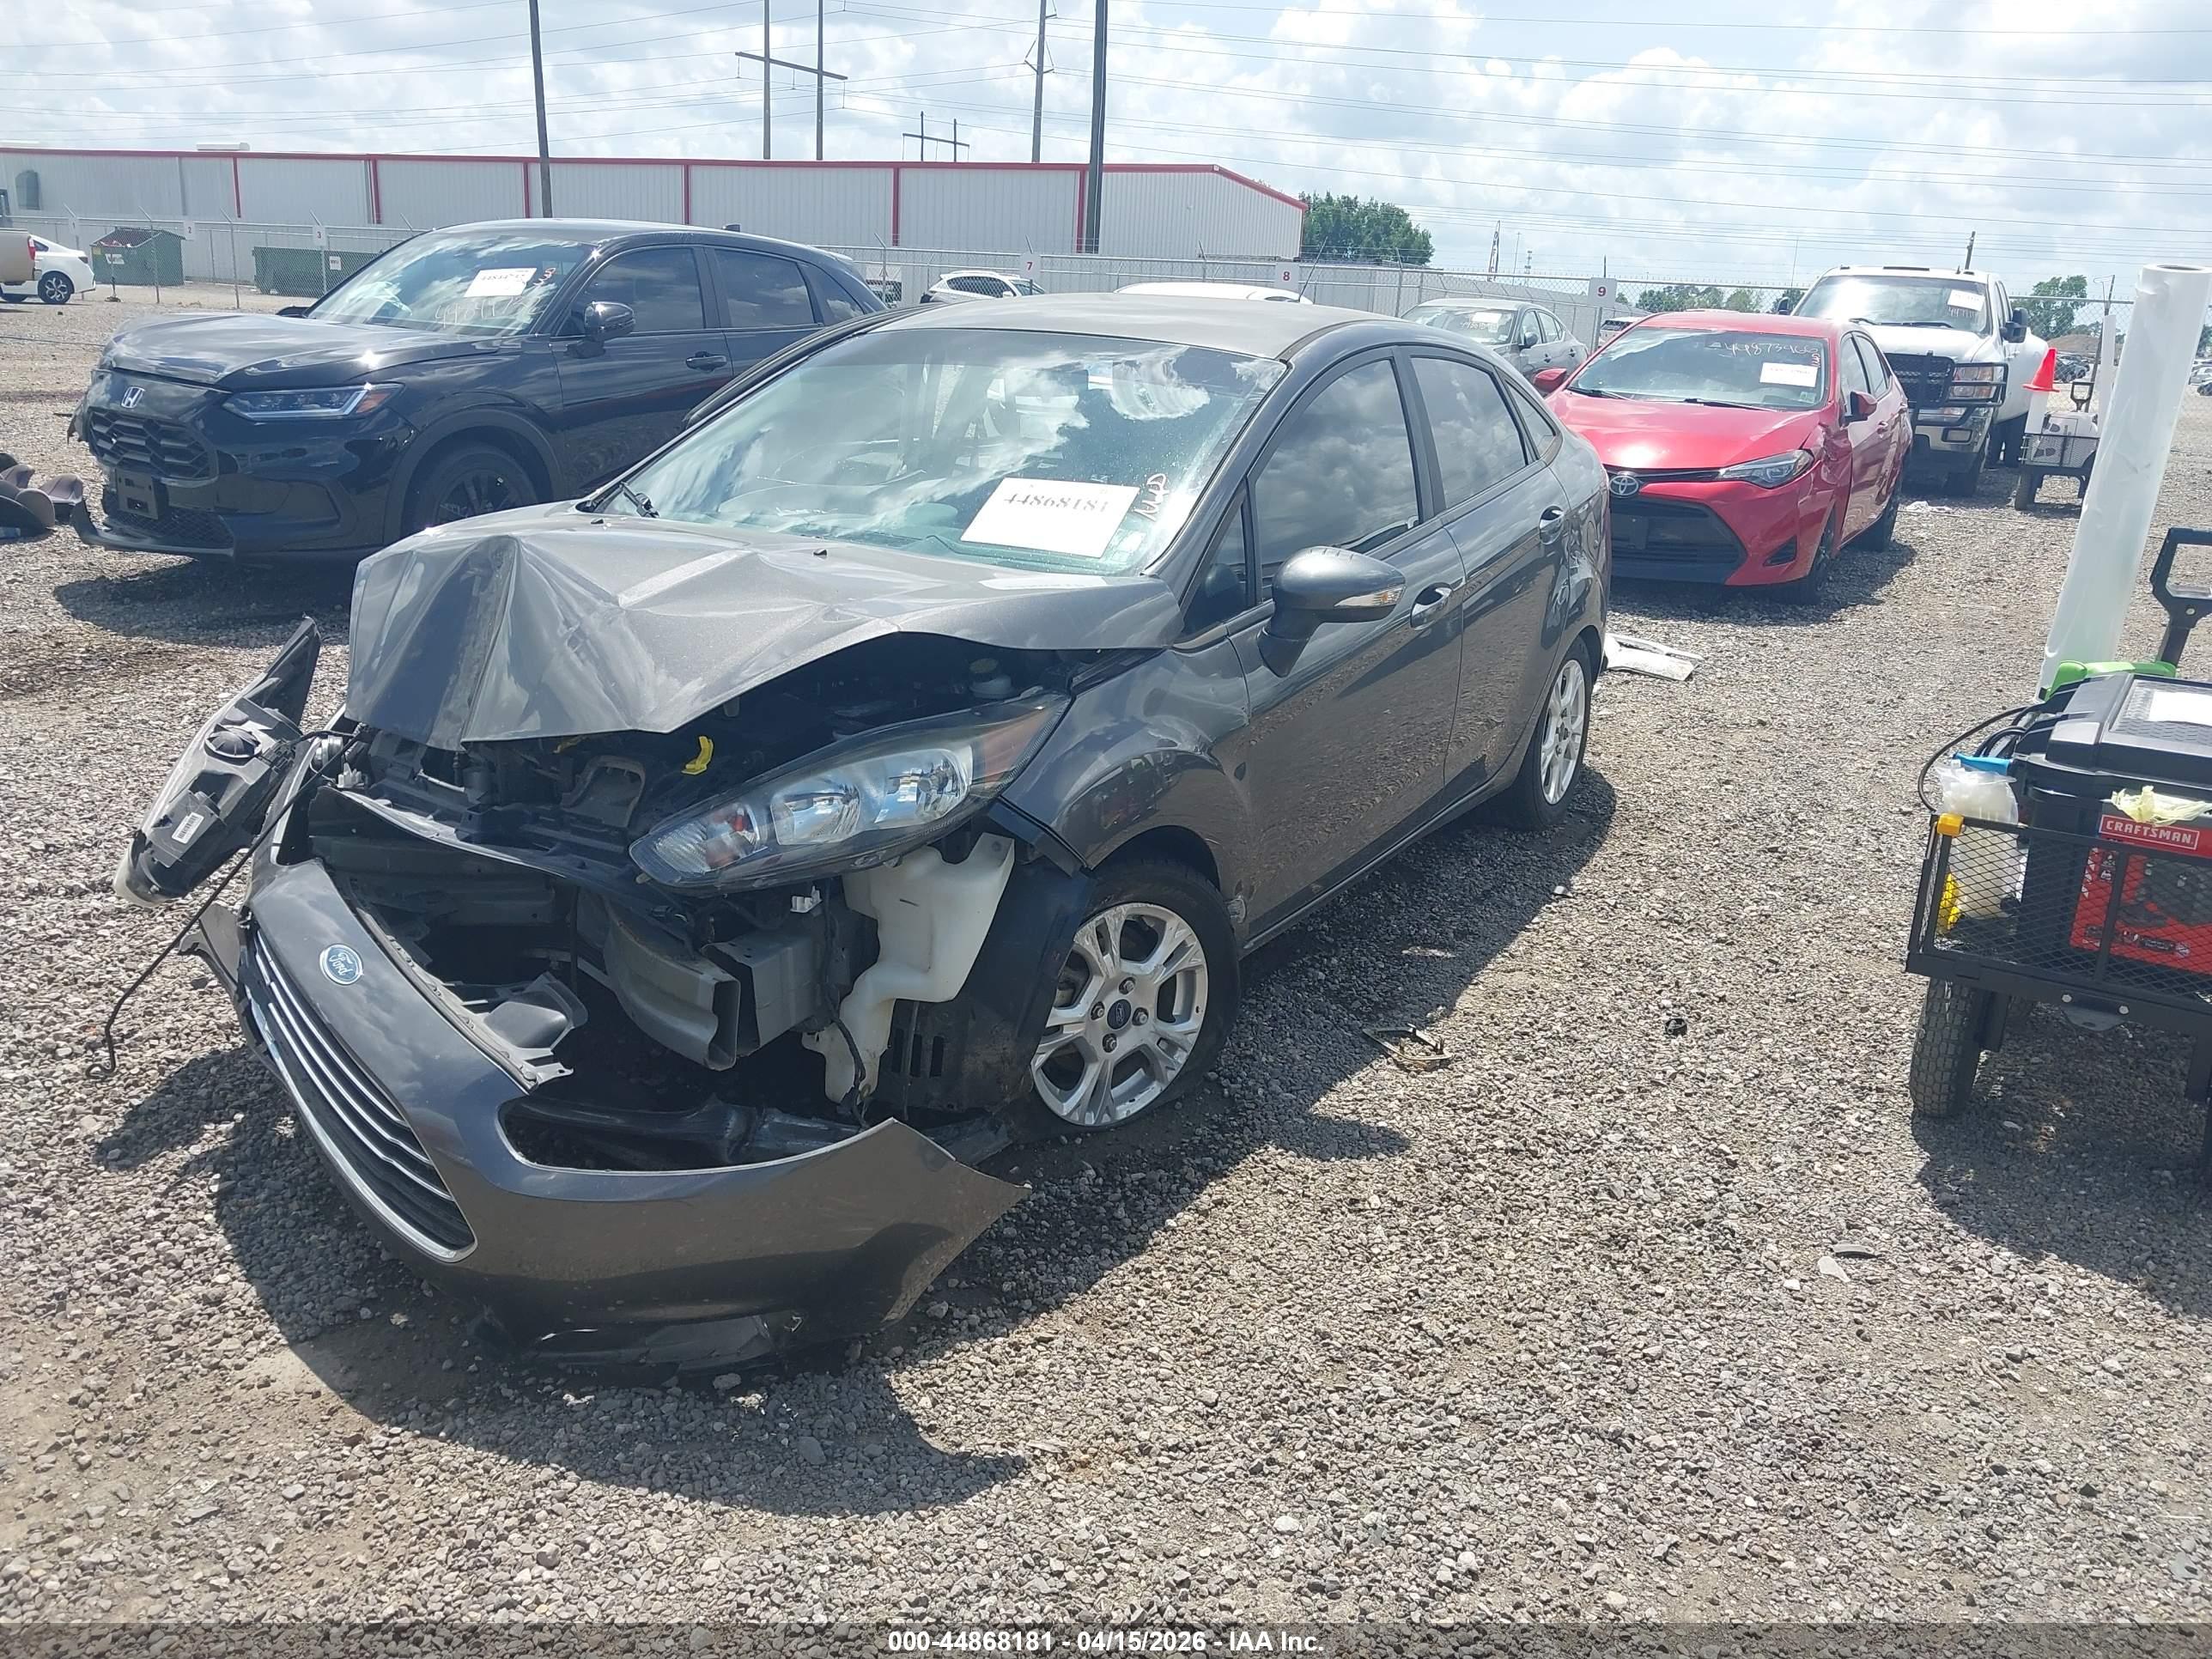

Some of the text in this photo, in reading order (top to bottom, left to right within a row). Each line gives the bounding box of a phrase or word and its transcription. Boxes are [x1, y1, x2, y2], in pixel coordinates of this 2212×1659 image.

[1026, 261, 1033, 270] 7
[1283, 270, 1291, 282] 8
[1597, 286, 1607, 297] 9
[1003, 493, 1109, 513] 44868181
[2106, 820, 2193, 844] CRAFTSMAN
